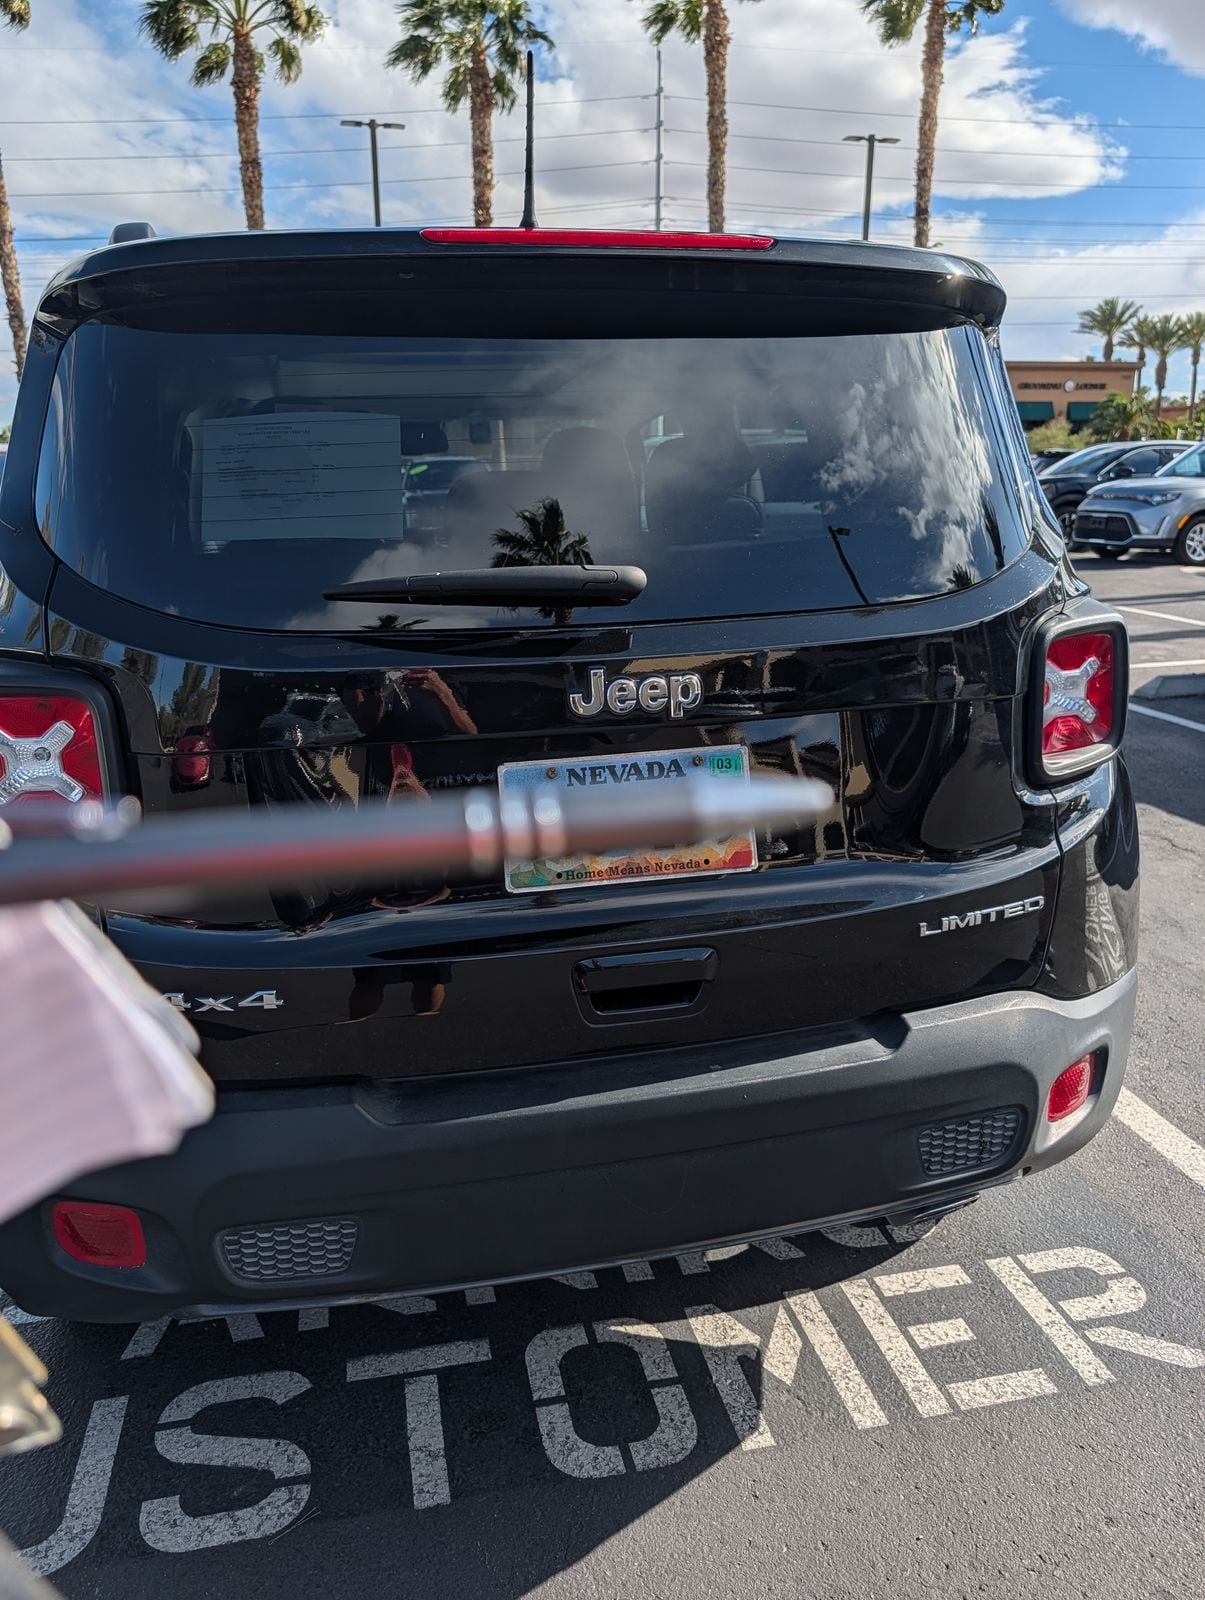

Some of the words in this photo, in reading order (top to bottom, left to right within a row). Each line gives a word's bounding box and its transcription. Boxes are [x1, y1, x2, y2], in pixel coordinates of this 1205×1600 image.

[568, 667, 703, 720] Jeep
[566, 758, 687, 787] NEVADA
[716, 757, 732, 770] 03
[565, 869, 604, 881] Home
[608, 865, 650, 877] Means
[654, 859, 701, 871] Nevada
[918, 895, 1046, 937] LIMITED
